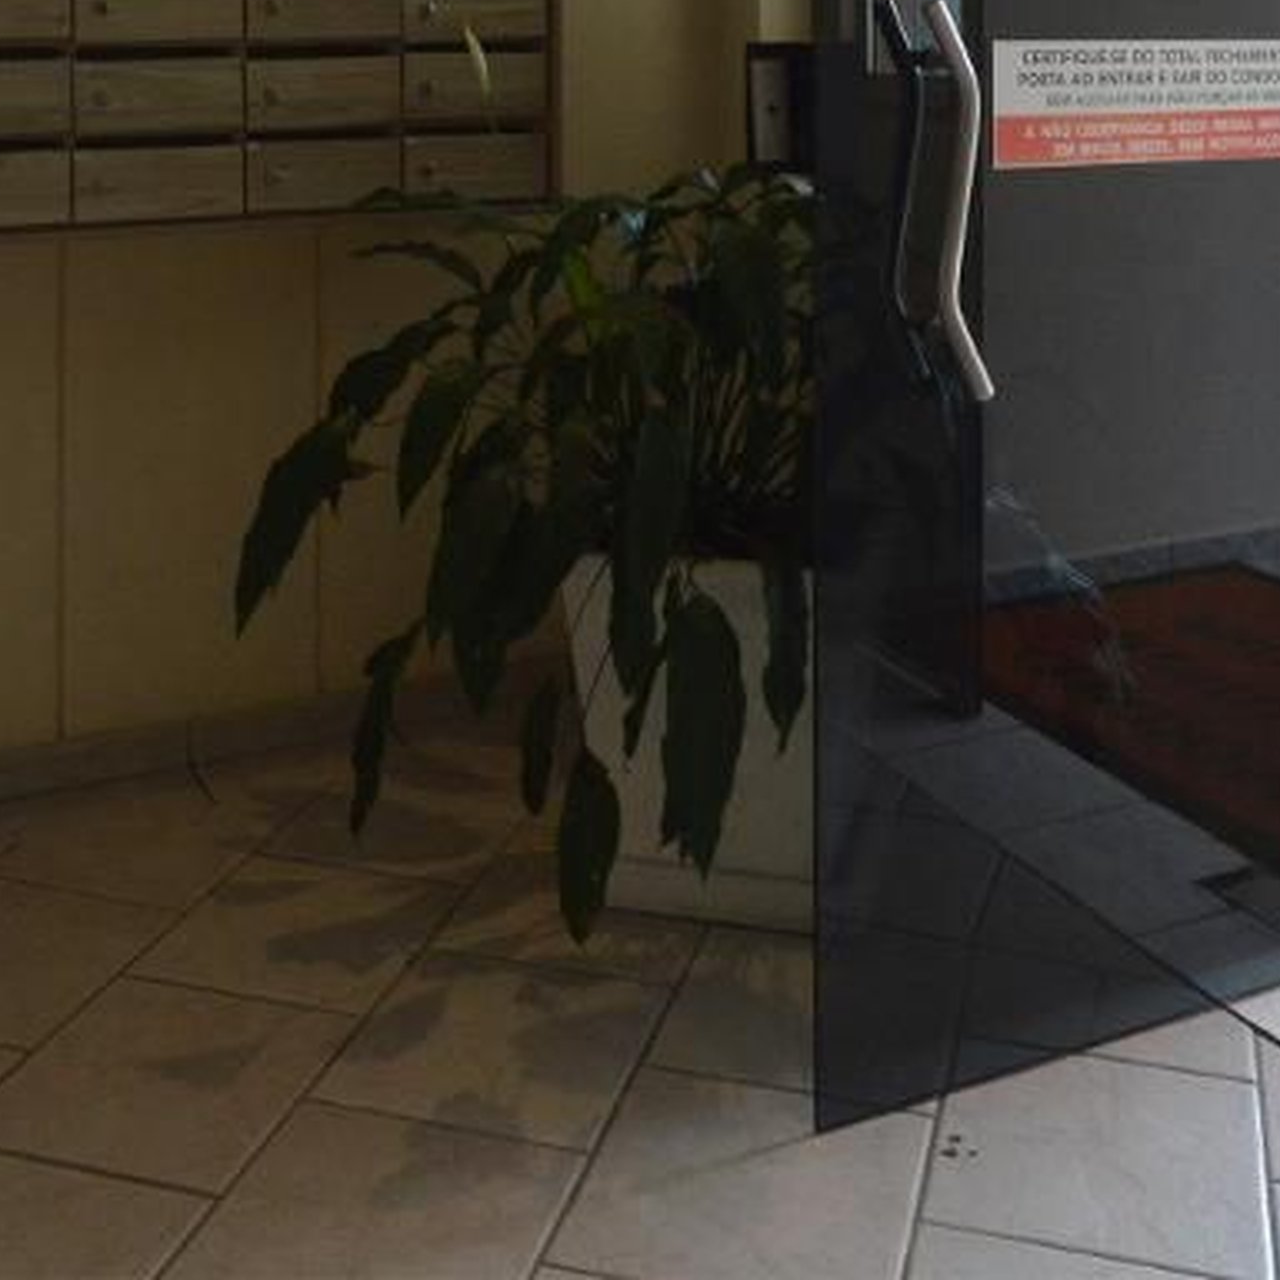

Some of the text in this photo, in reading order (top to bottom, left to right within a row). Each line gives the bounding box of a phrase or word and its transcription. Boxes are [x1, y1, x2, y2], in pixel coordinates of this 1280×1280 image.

[1132, 48, 1154, 64] DO
[1017, 70, 1066, 88] PORTA
[1071, 70, 1094, 87] AO
[1097, 69, 1153, 86] ENTRAR
[1158, 69, 1165, 85] E
[1206, 68, 1226, 84] DO
